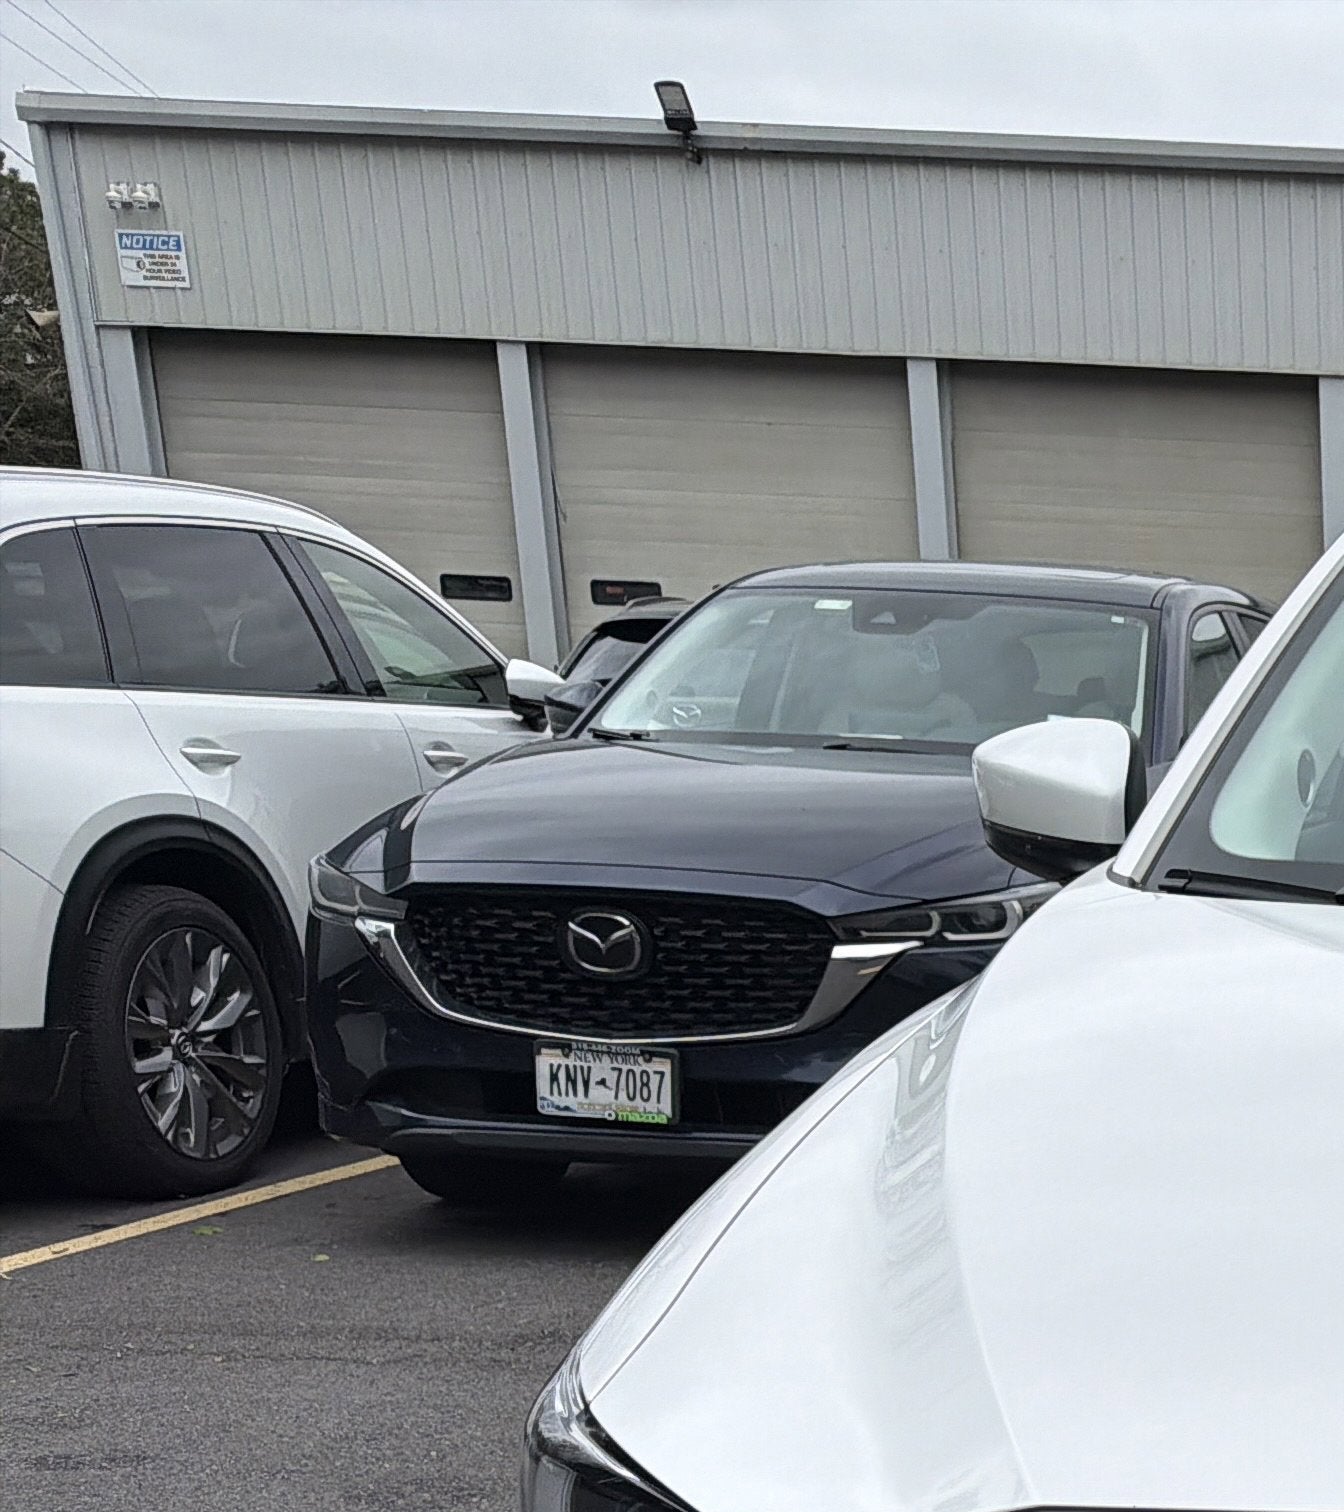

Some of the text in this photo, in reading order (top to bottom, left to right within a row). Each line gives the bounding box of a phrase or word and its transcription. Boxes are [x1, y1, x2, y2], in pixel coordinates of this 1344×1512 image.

[121, 234, 178, 250] NOTICE
[573, 1051, 643, 1066] NEW YORK
[549, 1063, 666, 1104] KNV 7087
